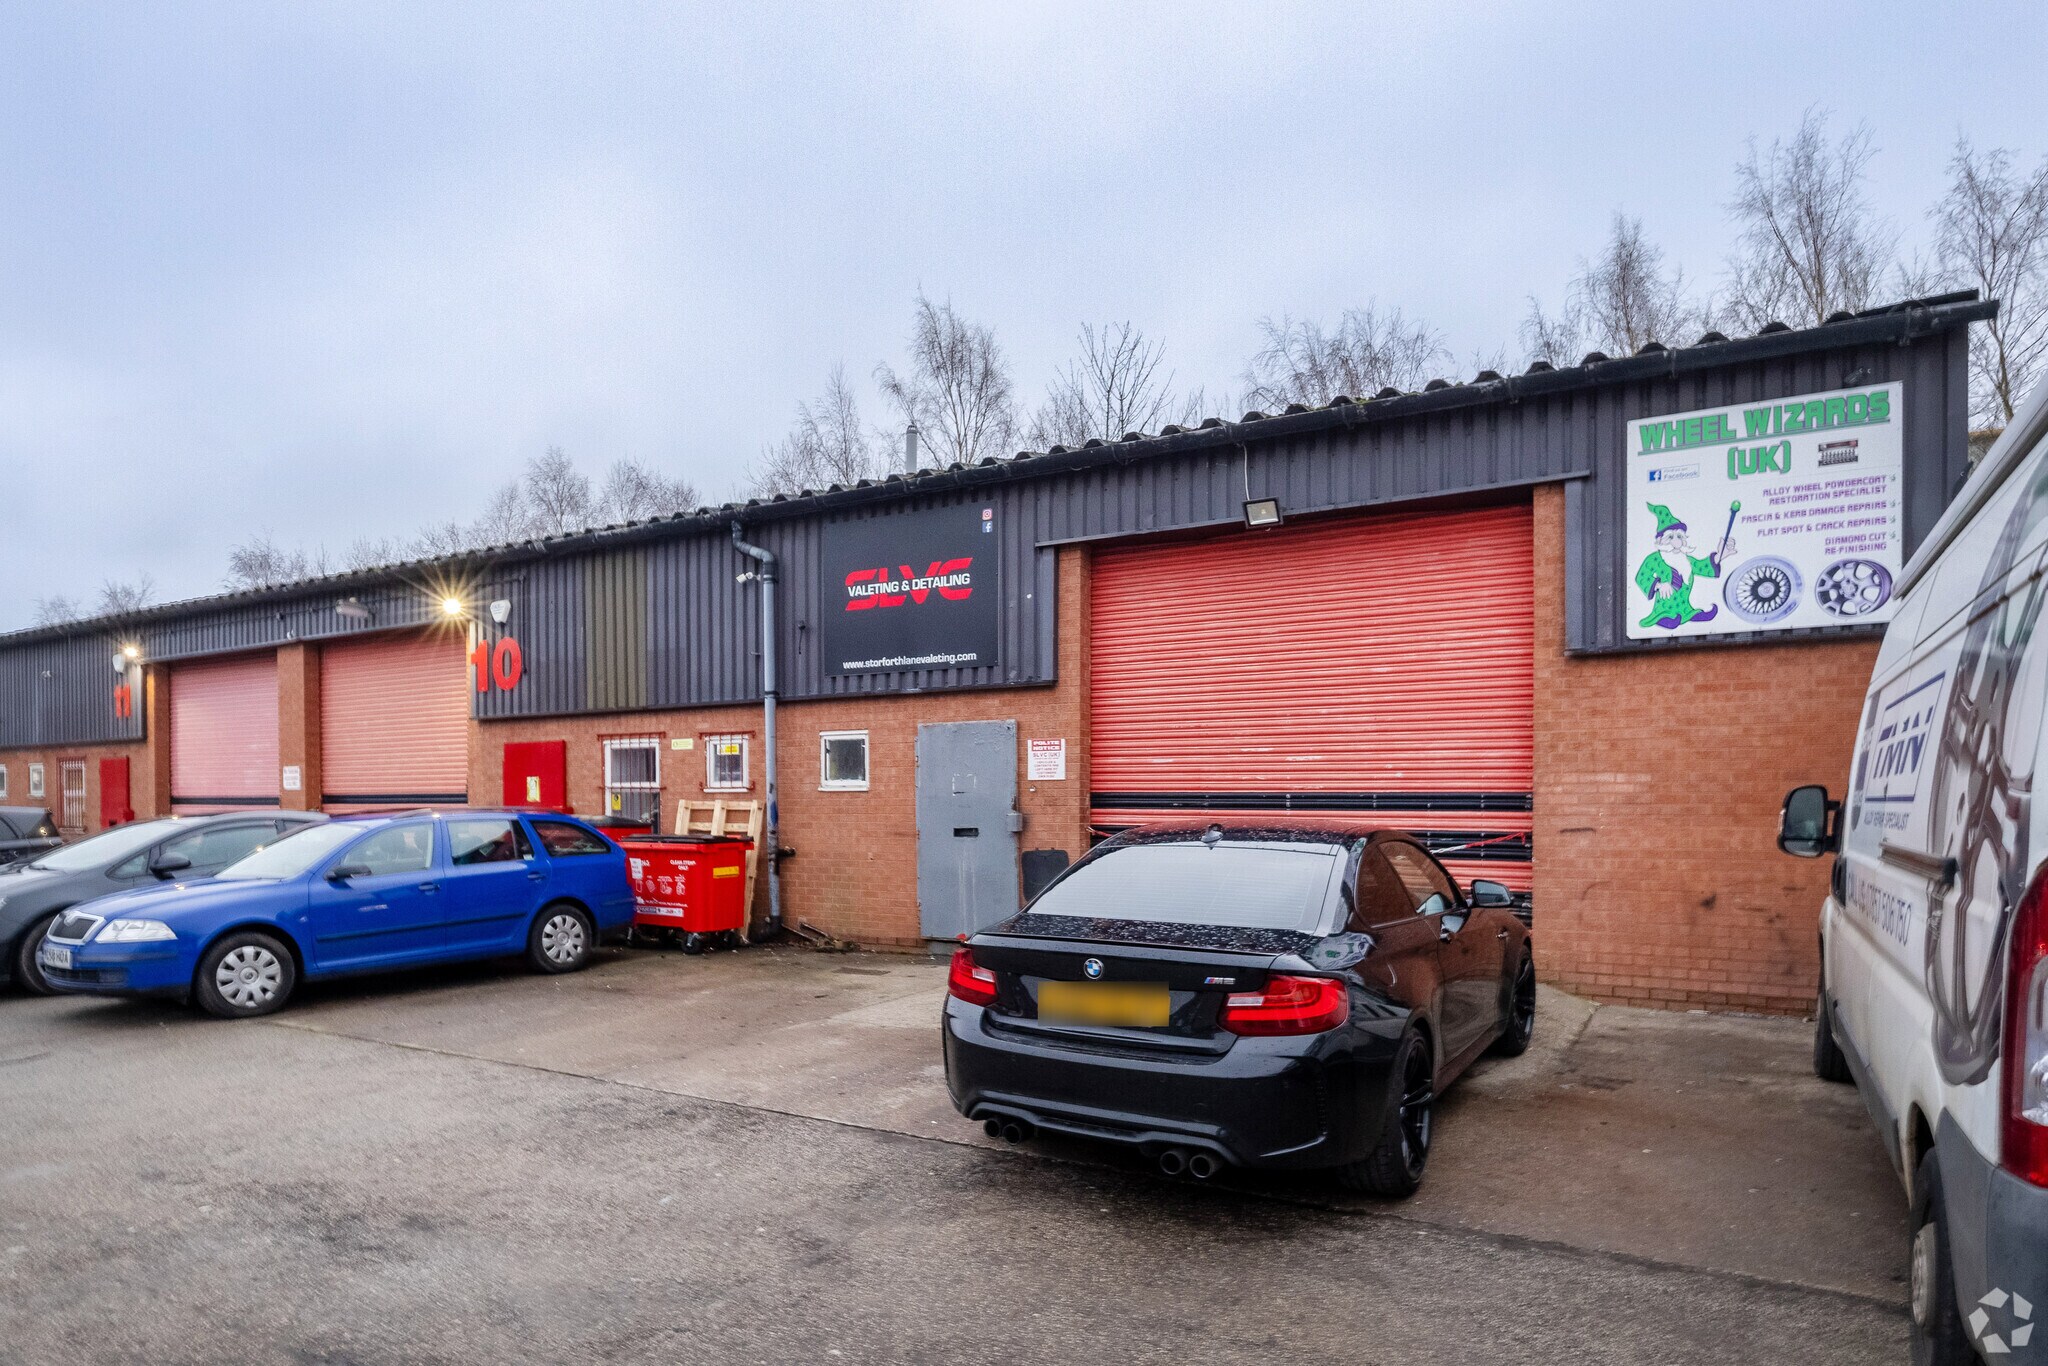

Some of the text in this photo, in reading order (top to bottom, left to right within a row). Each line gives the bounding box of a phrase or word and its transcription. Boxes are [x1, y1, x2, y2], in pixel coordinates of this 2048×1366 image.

[1639, 390, 1890, 451] WHEEL WIZARDS
[1763, 475, 1887, 497] ALLOY WHEEL POWDERCOAT
[1769, 484, 1887, 506] RESTORATION SPECIALIST
[1741, 513, 1773, 523] FASCIA
[1775, 511, 1781, 520] &
[1808, 504, 1845, 516] DAMAGE
[1847, 500, 1887, 512] REPAIRS
[1757, 516, 1887, 537] FLAT SPOT & CRACK REPAIRS
[1825, 531, 1887, 545] DIAMOND CUT
[1825, 541, 1887, 555] RE-FINISHING
[845, 557, 973, 611] SLVC
[847, 573, 971, 597] VALETING & DETAILING
[471, 636, 522, 692] 10
[842, 652, 977, 669] www.storforthlanevaleting.com
[114, 683, 131, 718] 11
